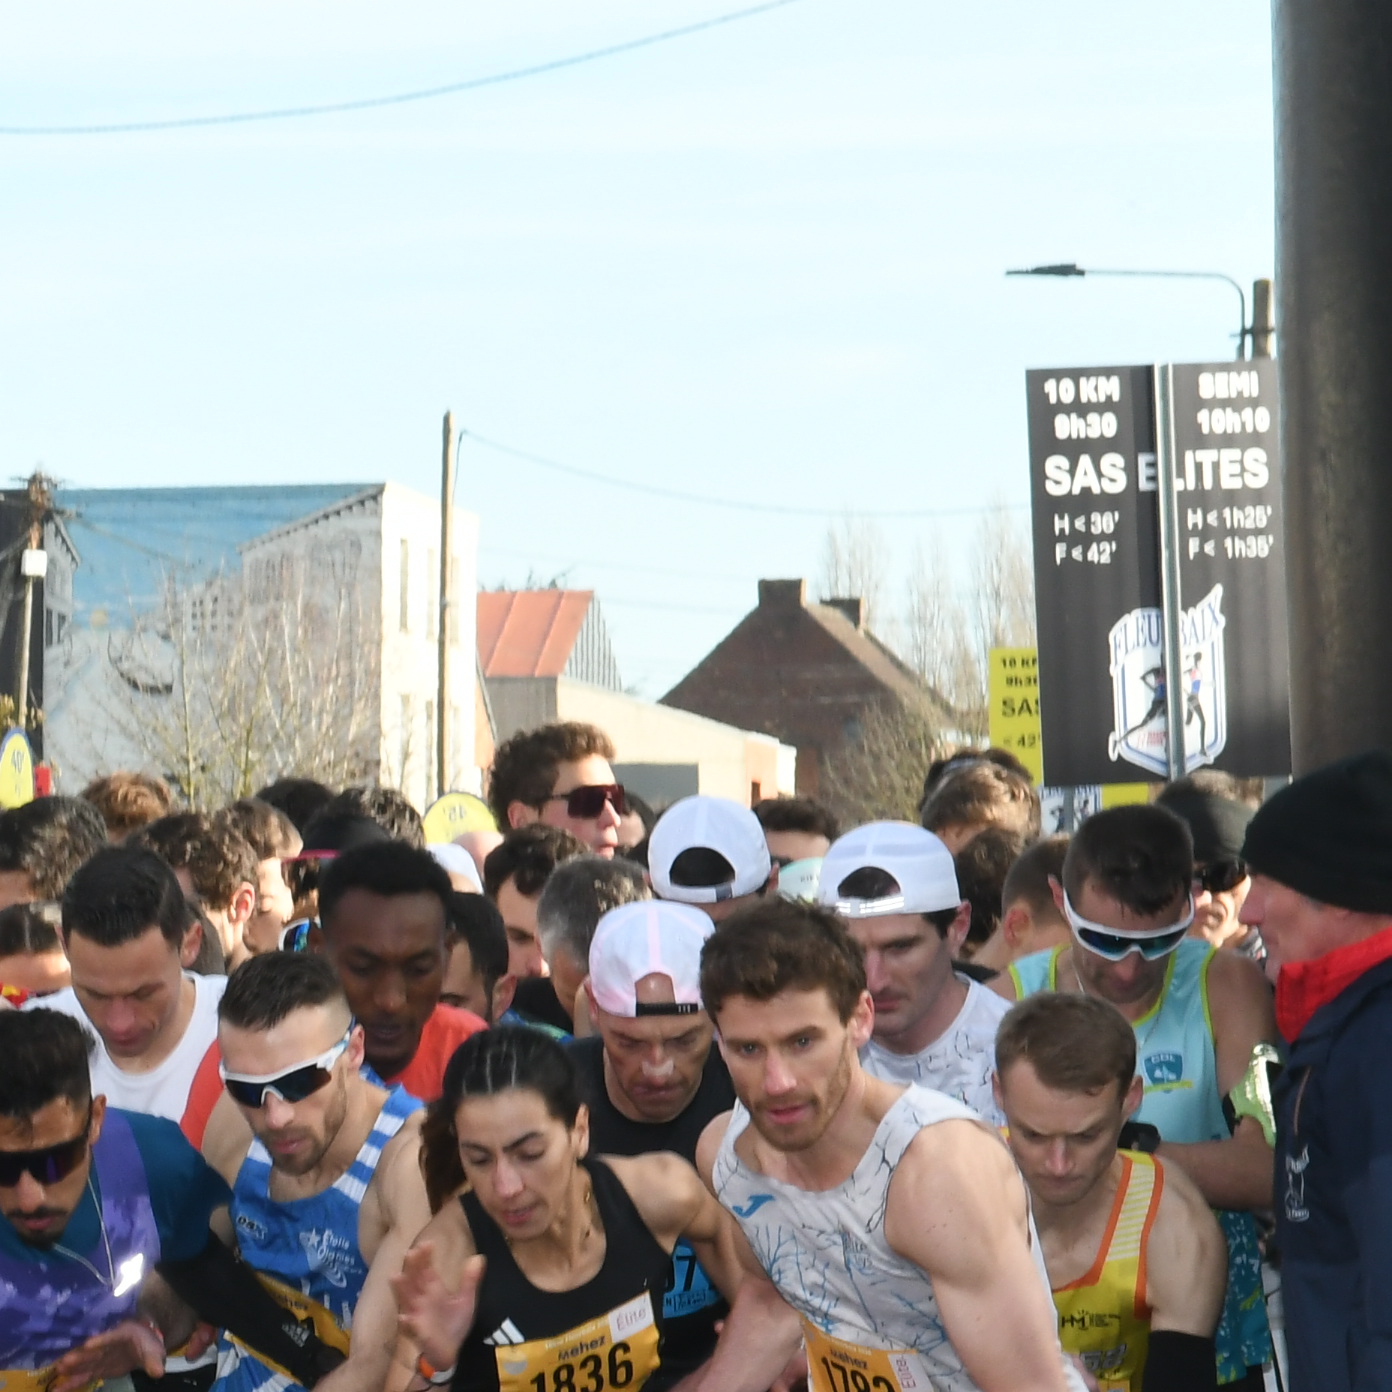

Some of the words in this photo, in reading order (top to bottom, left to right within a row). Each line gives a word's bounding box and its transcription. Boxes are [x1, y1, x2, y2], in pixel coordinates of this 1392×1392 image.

[1044, 378, 1075, 404] 10
[1080, 375, 1120, 402] KM
[1199, 371, 1259, 399] SEMI
[1054, 412, 1118, 439] 9h30
[1197, 406, 1270, 435] 10h10
[1045, 452, 1127, 496] SAS
[1054, 513, 1069, 536] H
[1187, 507, 1202, 530] H
[1055, 543, 1066, 566] F
[1189, 536, 1199, 560] F
[1112, 602, 1221, 655] FLEUBAIX
